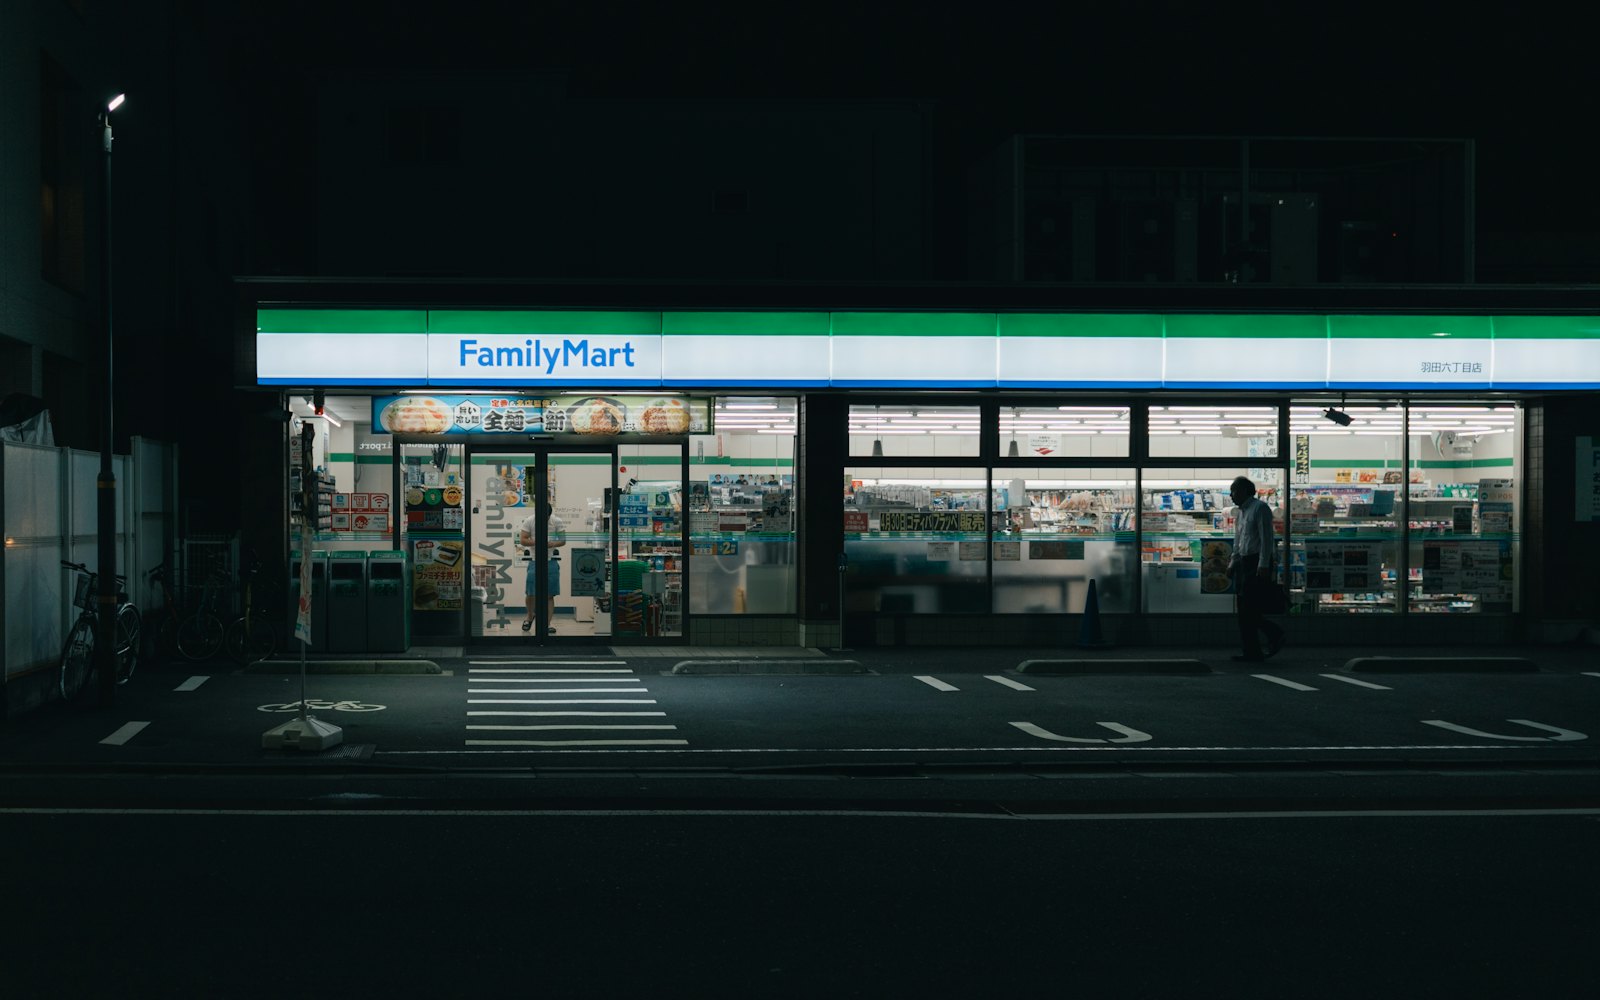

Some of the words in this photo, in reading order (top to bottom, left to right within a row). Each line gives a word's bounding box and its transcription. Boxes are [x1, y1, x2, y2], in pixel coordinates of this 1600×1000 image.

[459, 339, 635, 375] FamilyMart
[1420, 361, 1483, 373] 羽田六丁目店
[459, 406, 477, 415] 旨い
[483, 409, 566, 432] 全麺一新
[623, 506, 644, 514] たばこ
[478, 459, 513, 629] FamilyMart
[415, 571, 461, 580] ファミチキ祭り
